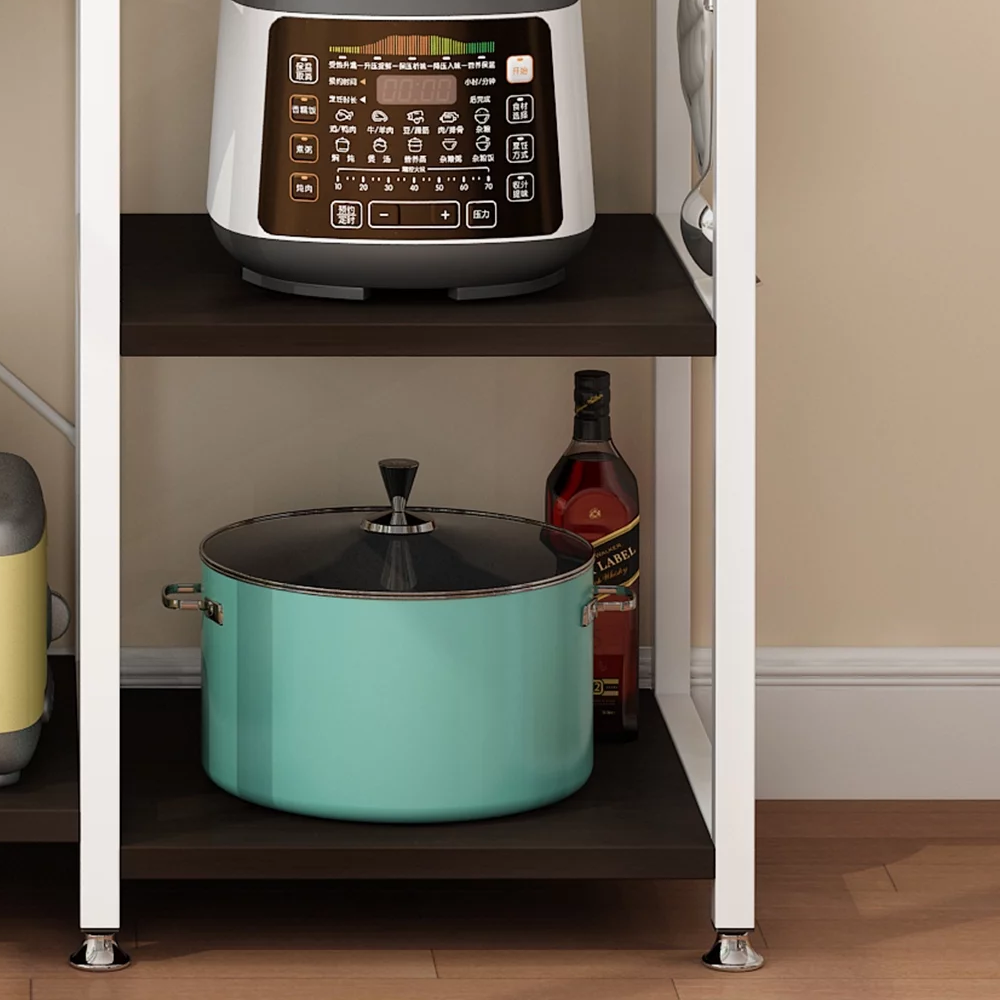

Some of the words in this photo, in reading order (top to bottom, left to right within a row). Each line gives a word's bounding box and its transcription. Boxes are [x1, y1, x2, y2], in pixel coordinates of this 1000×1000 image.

[512, 66, 529, 76] 开始
[512, 151, 528, 160] 方式
[335, 182, 342, 190] 10
[359, 183, 368, 191] 20
[384, 184, 394, 192] 30
[409, 184, 419, 192] 40
[460, 183, 469, 191] 60
[473, 209, 490, 219] 压力
[597, 546, 637, 571] LABEL
